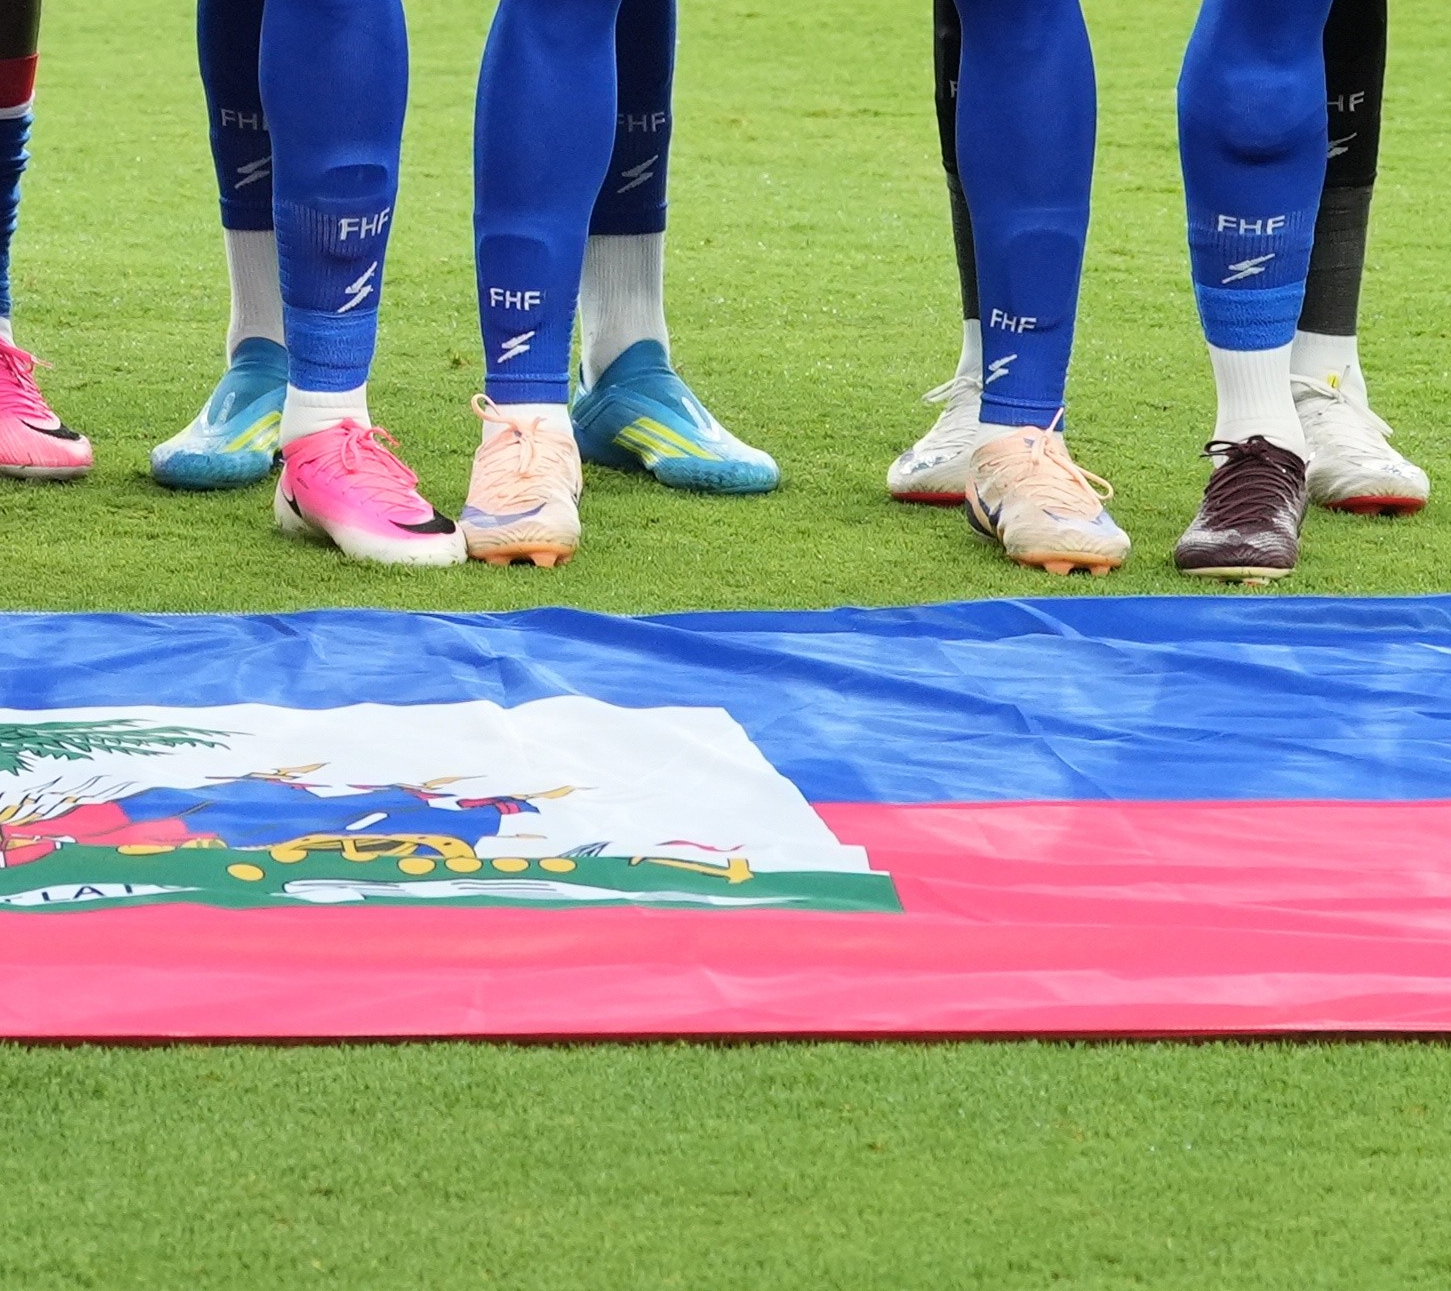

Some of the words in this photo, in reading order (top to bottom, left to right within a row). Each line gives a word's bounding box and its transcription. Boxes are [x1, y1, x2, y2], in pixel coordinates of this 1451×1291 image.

[338, 207, 390, 241] FHF
[1218, 215, 1285, 236] FHF
[489, 288, 541, 310] FHF
[990, 308, 1037, 334] FHF
